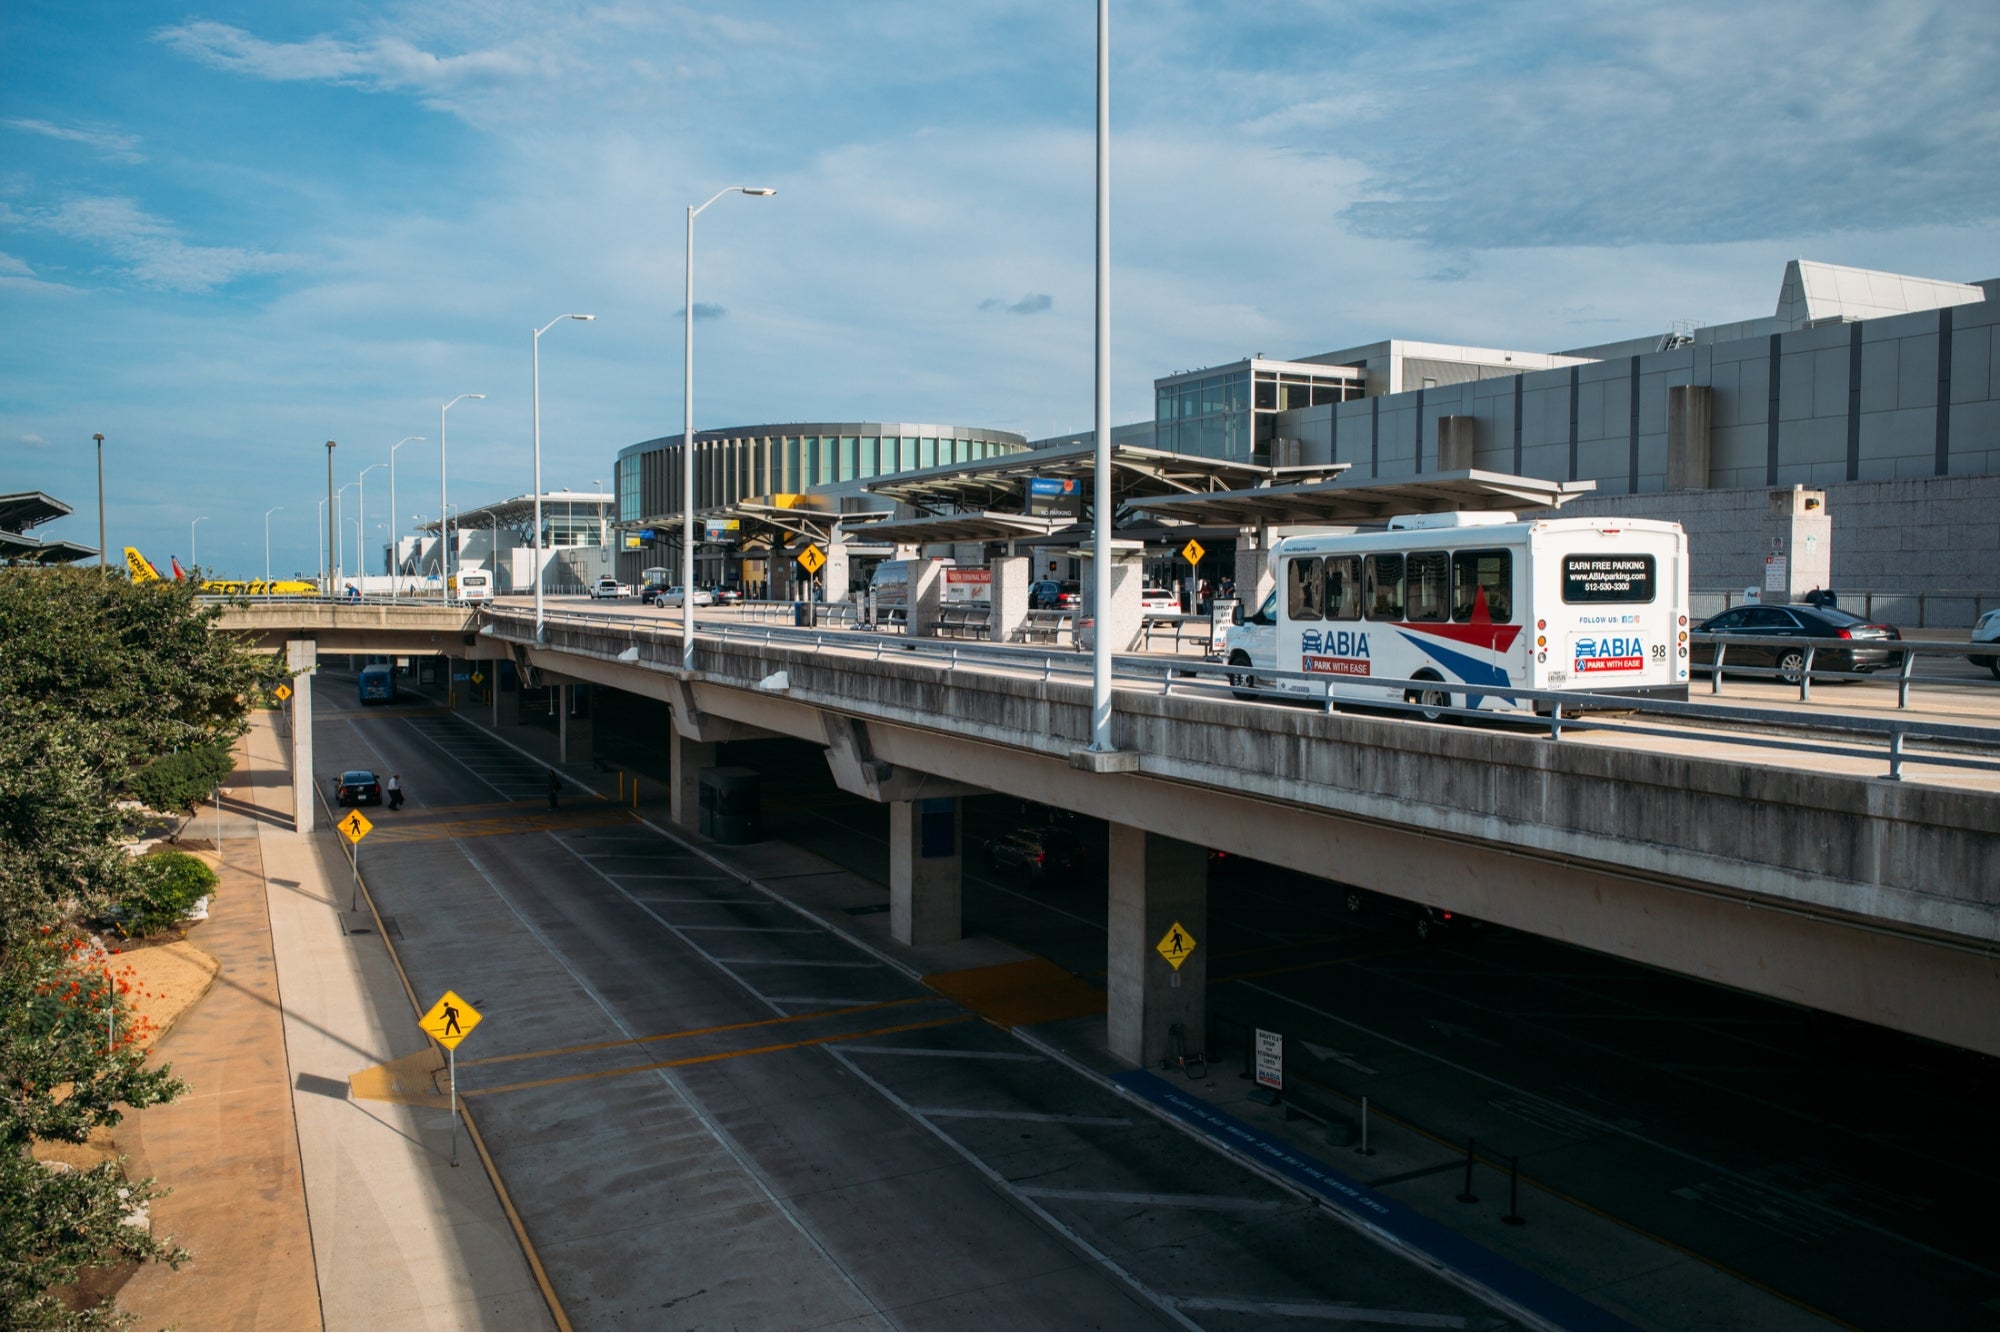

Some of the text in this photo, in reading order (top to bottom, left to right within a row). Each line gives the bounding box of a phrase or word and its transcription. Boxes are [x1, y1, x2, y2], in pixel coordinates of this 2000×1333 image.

[1569, 562, 1645, 570] EARN FREE PARKING
[1570, 572, 1646, 581] www.ABIAparking.com
[1323, 631, 1370, 657] ABIA
[1598, 638, 1643, 657] ABIA
[1652, 645, 1666, 657] 98
[1314, 660, 1367, 673] PARK WITH EASE
